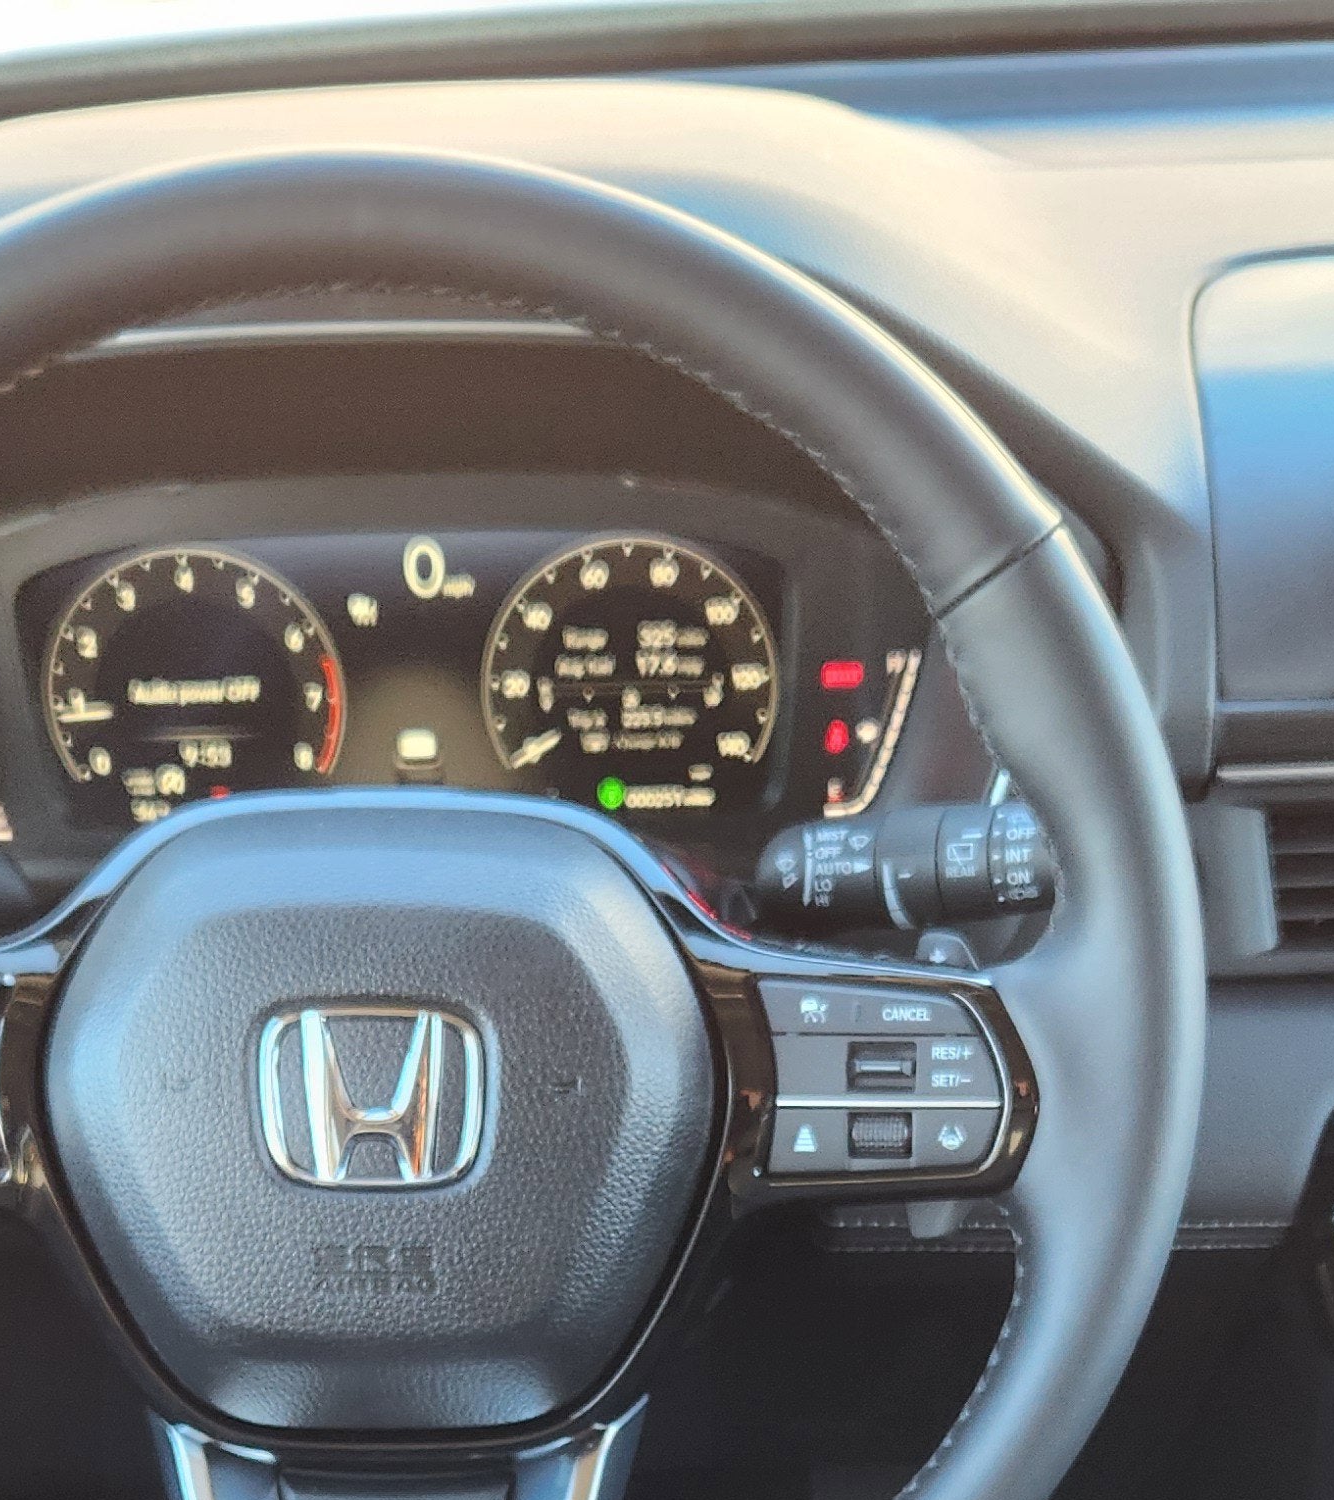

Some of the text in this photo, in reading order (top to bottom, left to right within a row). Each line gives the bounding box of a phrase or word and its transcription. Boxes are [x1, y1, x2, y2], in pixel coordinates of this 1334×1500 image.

[403, 534, 445, 599] 0
[76, 626, 98, 659] 2
[815, 827, 849, 843] MIST
[1006, 825, 1037, 842] OFF
[814, 844, 842, 861] OFF
[1005, 846, 1033, 864] INT
[814, 860, 854, 876] AUTO
[1006, 868, 1033, 885] ON
[814, 877, 833, 893] LO
[881, 1004, 932, 1022] CANCEL
[931, 1042, 974, 1061] RES/+
